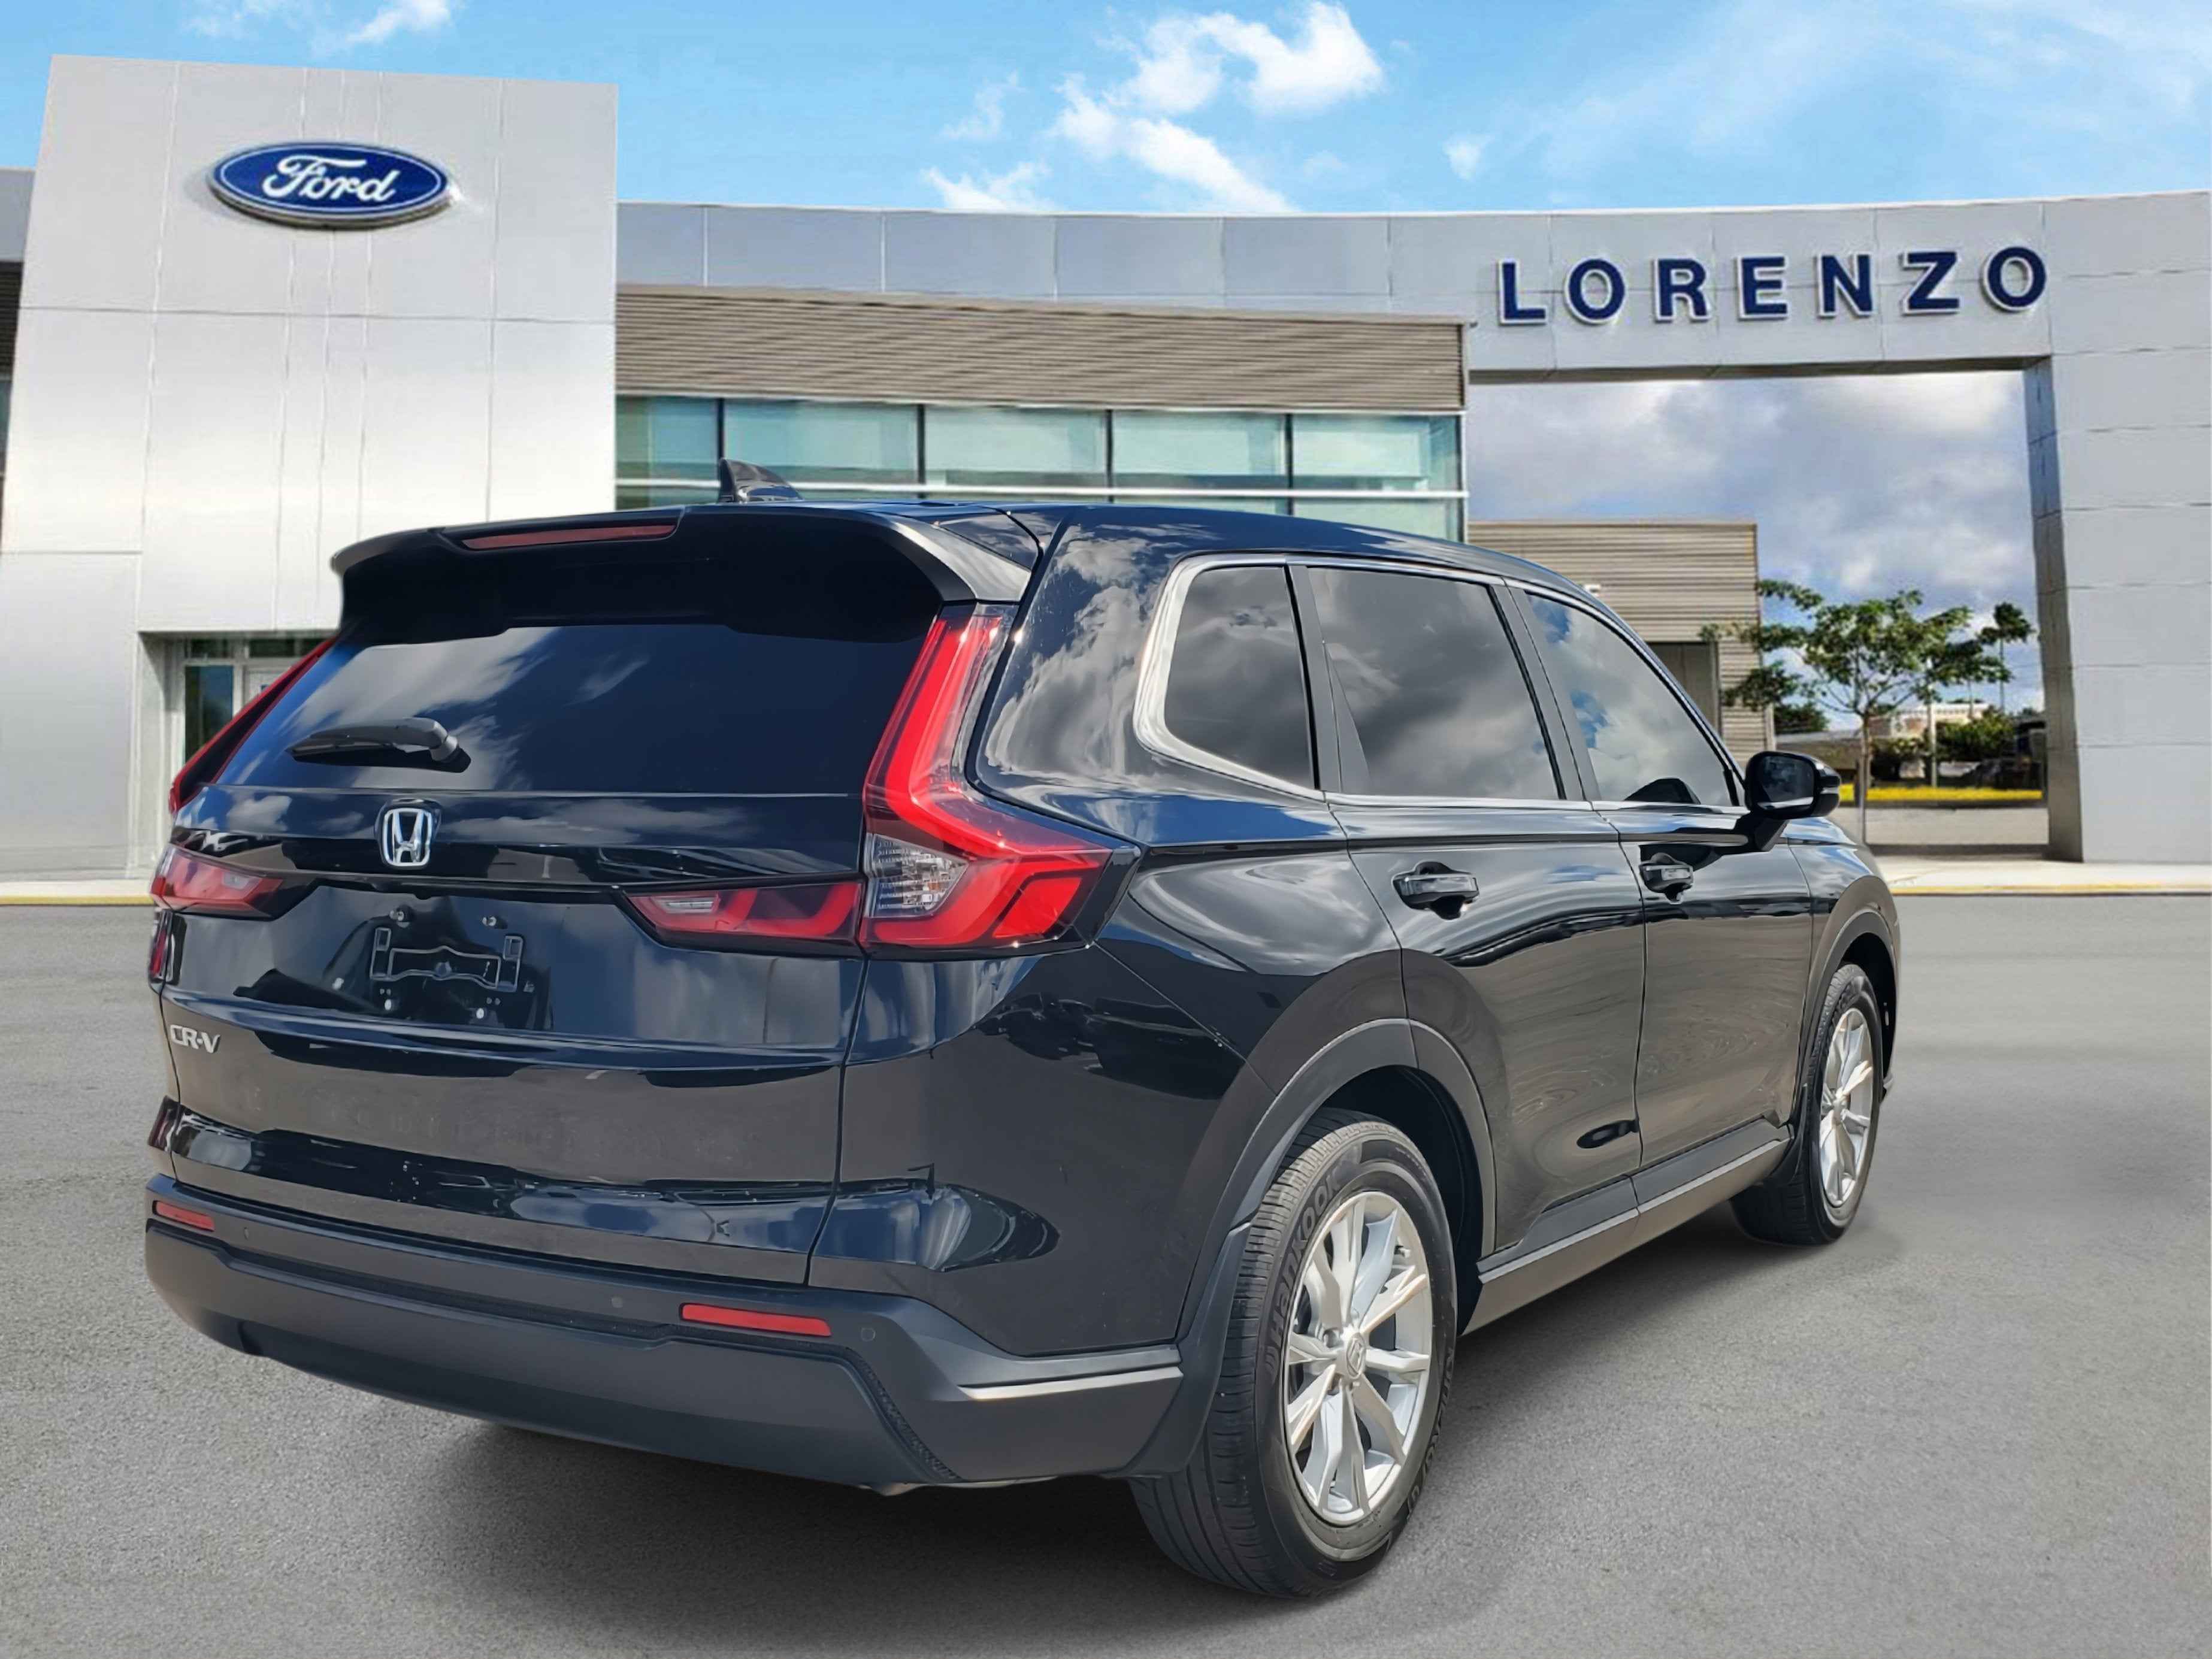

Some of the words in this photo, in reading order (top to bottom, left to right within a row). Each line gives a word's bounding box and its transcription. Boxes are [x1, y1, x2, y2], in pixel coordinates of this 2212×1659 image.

[262, 154, 400, 202] Ford
[1499, 246, 2047, 325] LORENZO
[170, 1024, 220, 1053] CR-V
